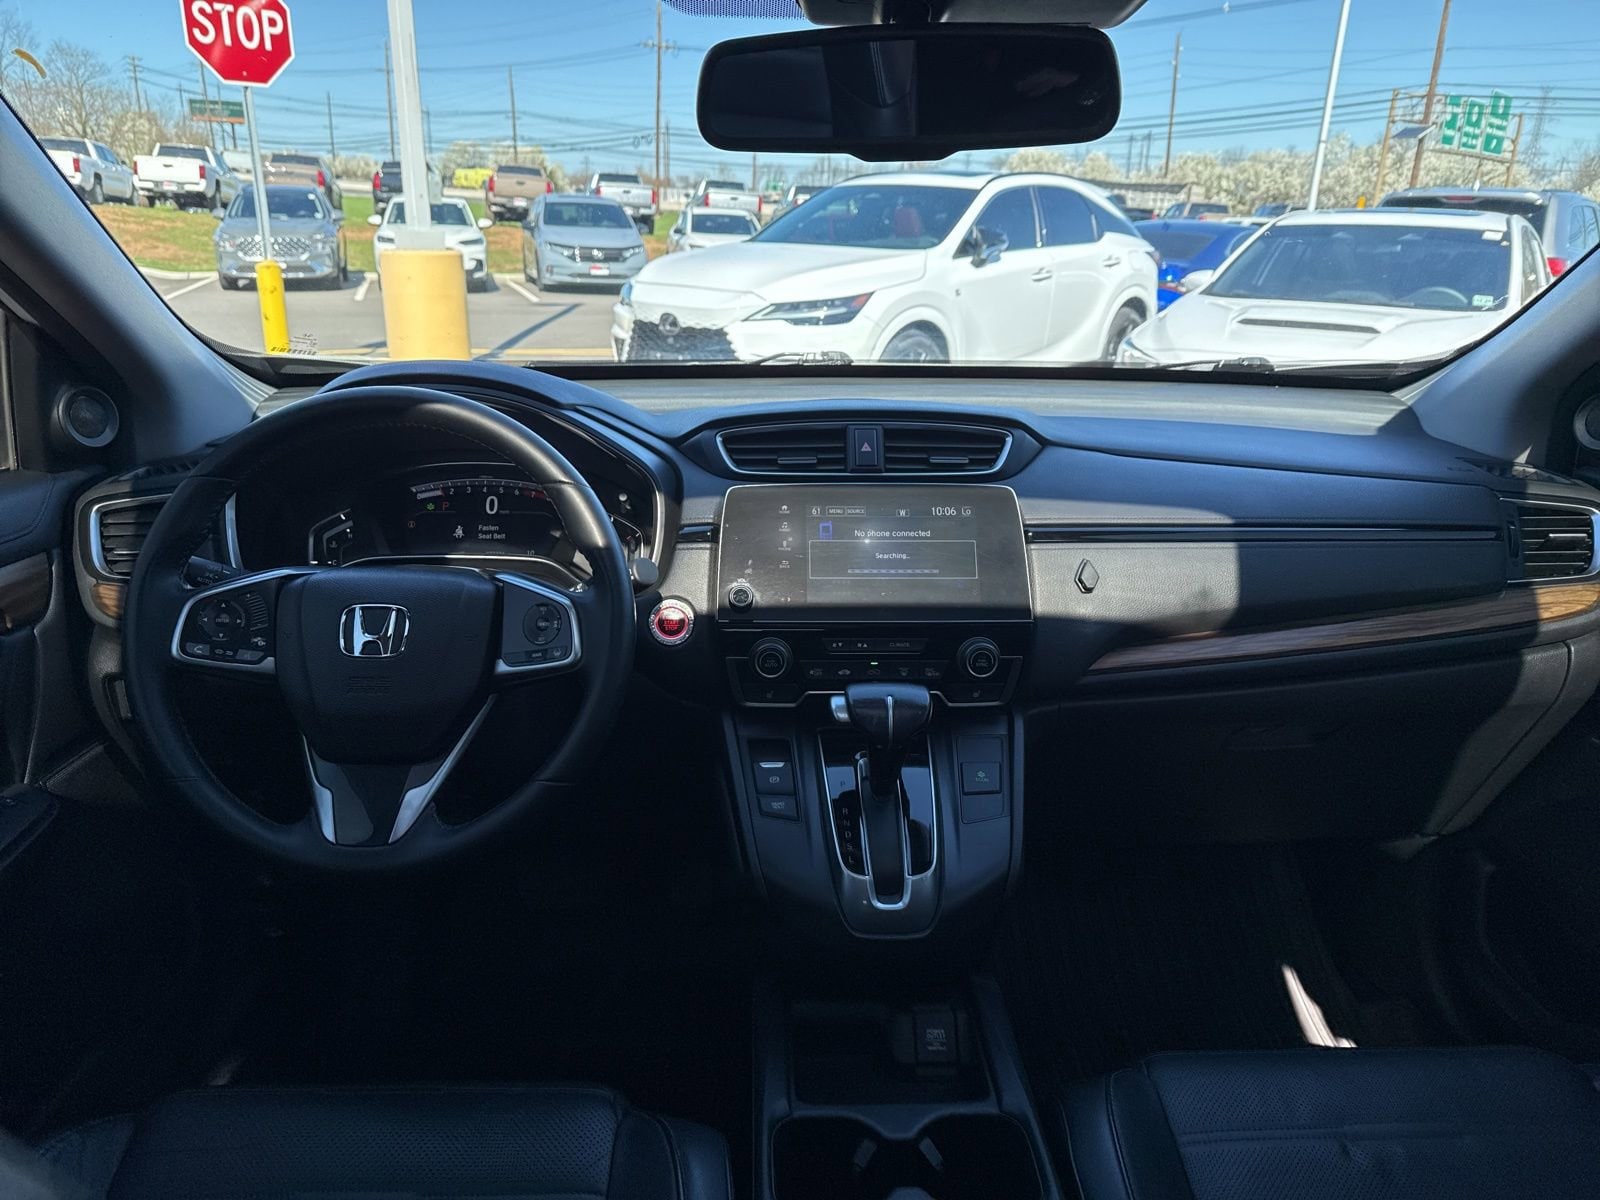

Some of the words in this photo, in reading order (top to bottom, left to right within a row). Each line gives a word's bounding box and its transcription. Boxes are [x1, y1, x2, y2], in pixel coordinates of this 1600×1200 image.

[191, 0, 285, 52] STOP
[449, 487, 455, 495] 2
[466, 486, 472, 494] 3
[482, 486, 488, 494] 4
[514, 488, 520, 496] 6
[485, 495, 499, 515] 0
[811, 507, 821, 515] 61
[931, 506, 957, 516] 10:06
[477, 524, 499, 532] Fasten
[477, 532, 492, 540] Seat
[493, 532, 506, 540] Belt
[854, 529, 865, 537] No
[867, 529, 890, 538] phone
[892, 529, 931, 537] connected
